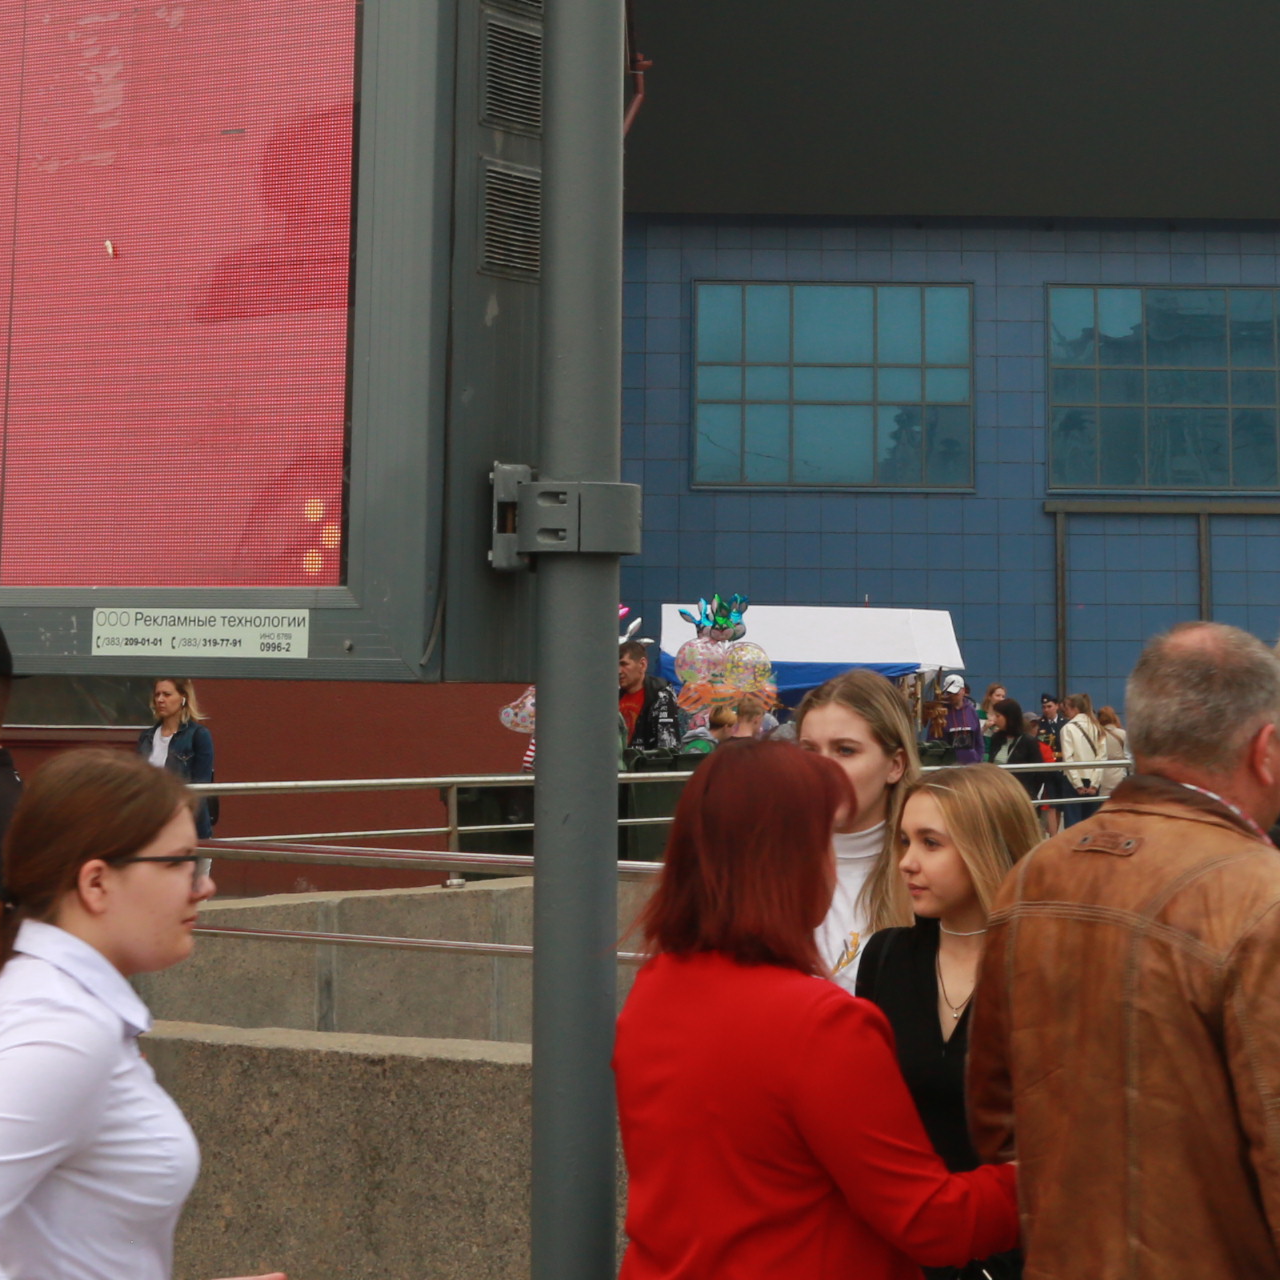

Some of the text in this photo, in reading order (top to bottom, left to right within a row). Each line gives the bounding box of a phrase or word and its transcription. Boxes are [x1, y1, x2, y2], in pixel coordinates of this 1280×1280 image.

[96, 611, 307, 629] ООО Рекламные технологии
[259, 641, 292, 653] 0996-2
